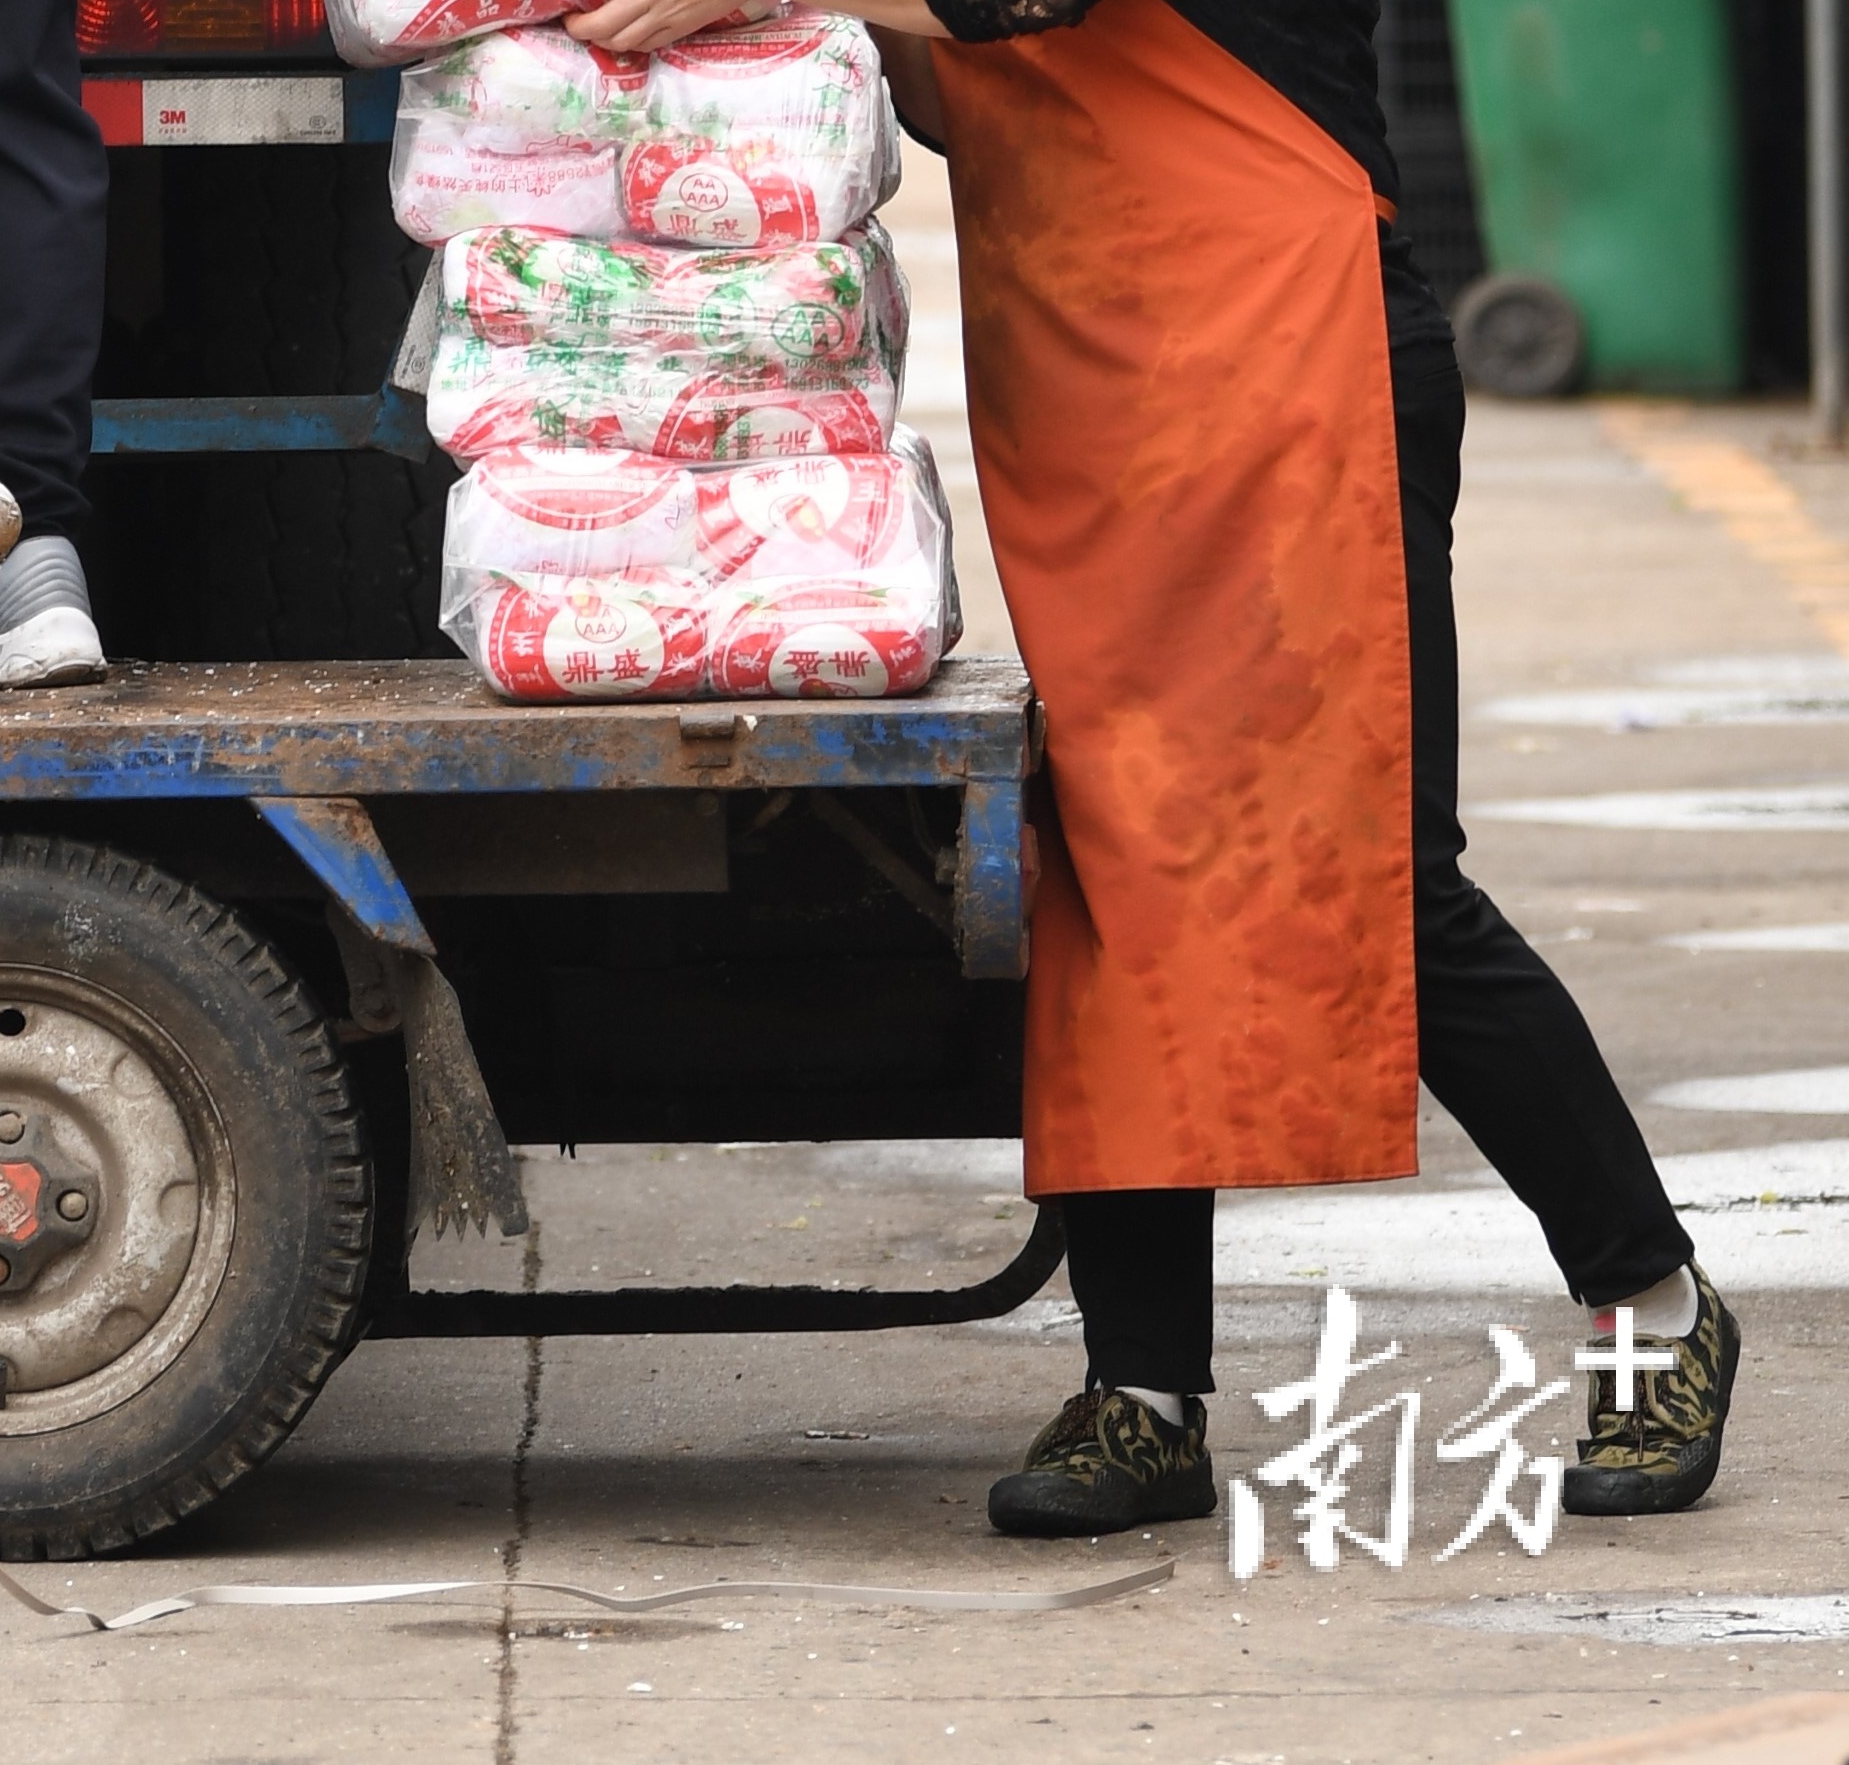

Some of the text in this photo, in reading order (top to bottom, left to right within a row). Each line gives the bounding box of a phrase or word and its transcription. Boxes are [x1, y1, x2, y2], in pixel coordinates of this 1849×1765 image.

[158, 110, 187, 126] 3M
[692, 178, 717, 190] AA
[684, 190, 722, 206] AAA
[582, 623, 621, 638] AAA
[563, 648, 651, 684] 鼎盛
[783, 649, 871, 681] 鼎盛
